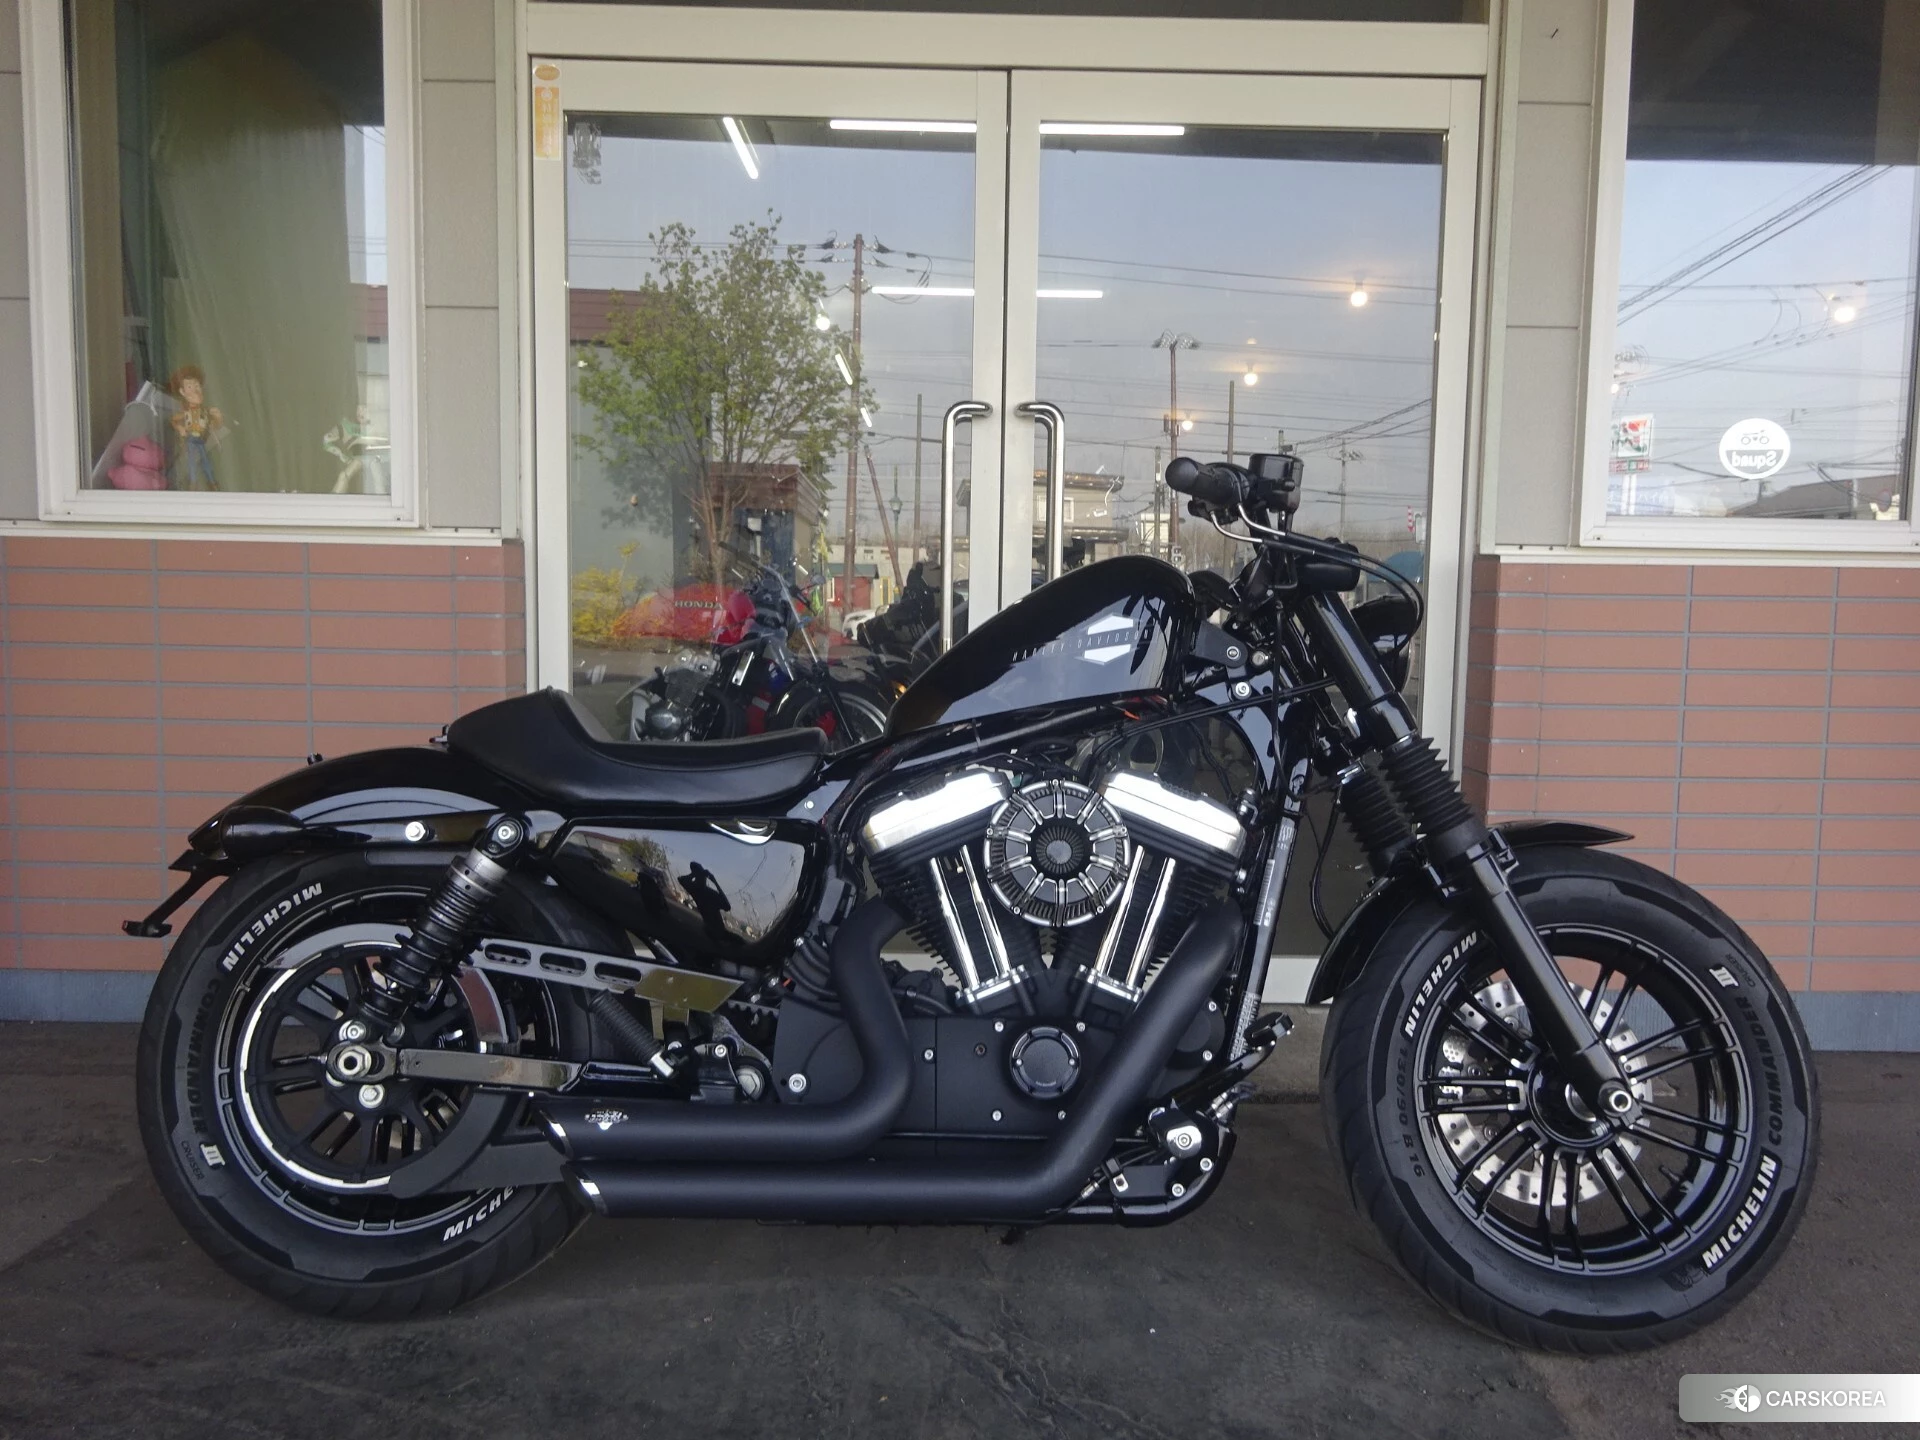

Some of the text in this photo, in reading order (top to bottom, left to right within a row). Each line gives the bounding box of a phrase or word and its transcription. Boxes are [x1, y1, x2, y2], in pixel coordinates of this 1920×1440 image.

[674, 600, 724, 610] HONDA
[222, 882, 322, 971] MICHELIN
[1404, 931, 1477, 1037] MICHELIN
[187, 978, 221, 1134] COMMANDER
[1735, 996, 1783, 1147] COMMANDER
[181, 1141, 205, 1180] CRUISER
[1702, 1154, 1777, 1268] MICHELIN
